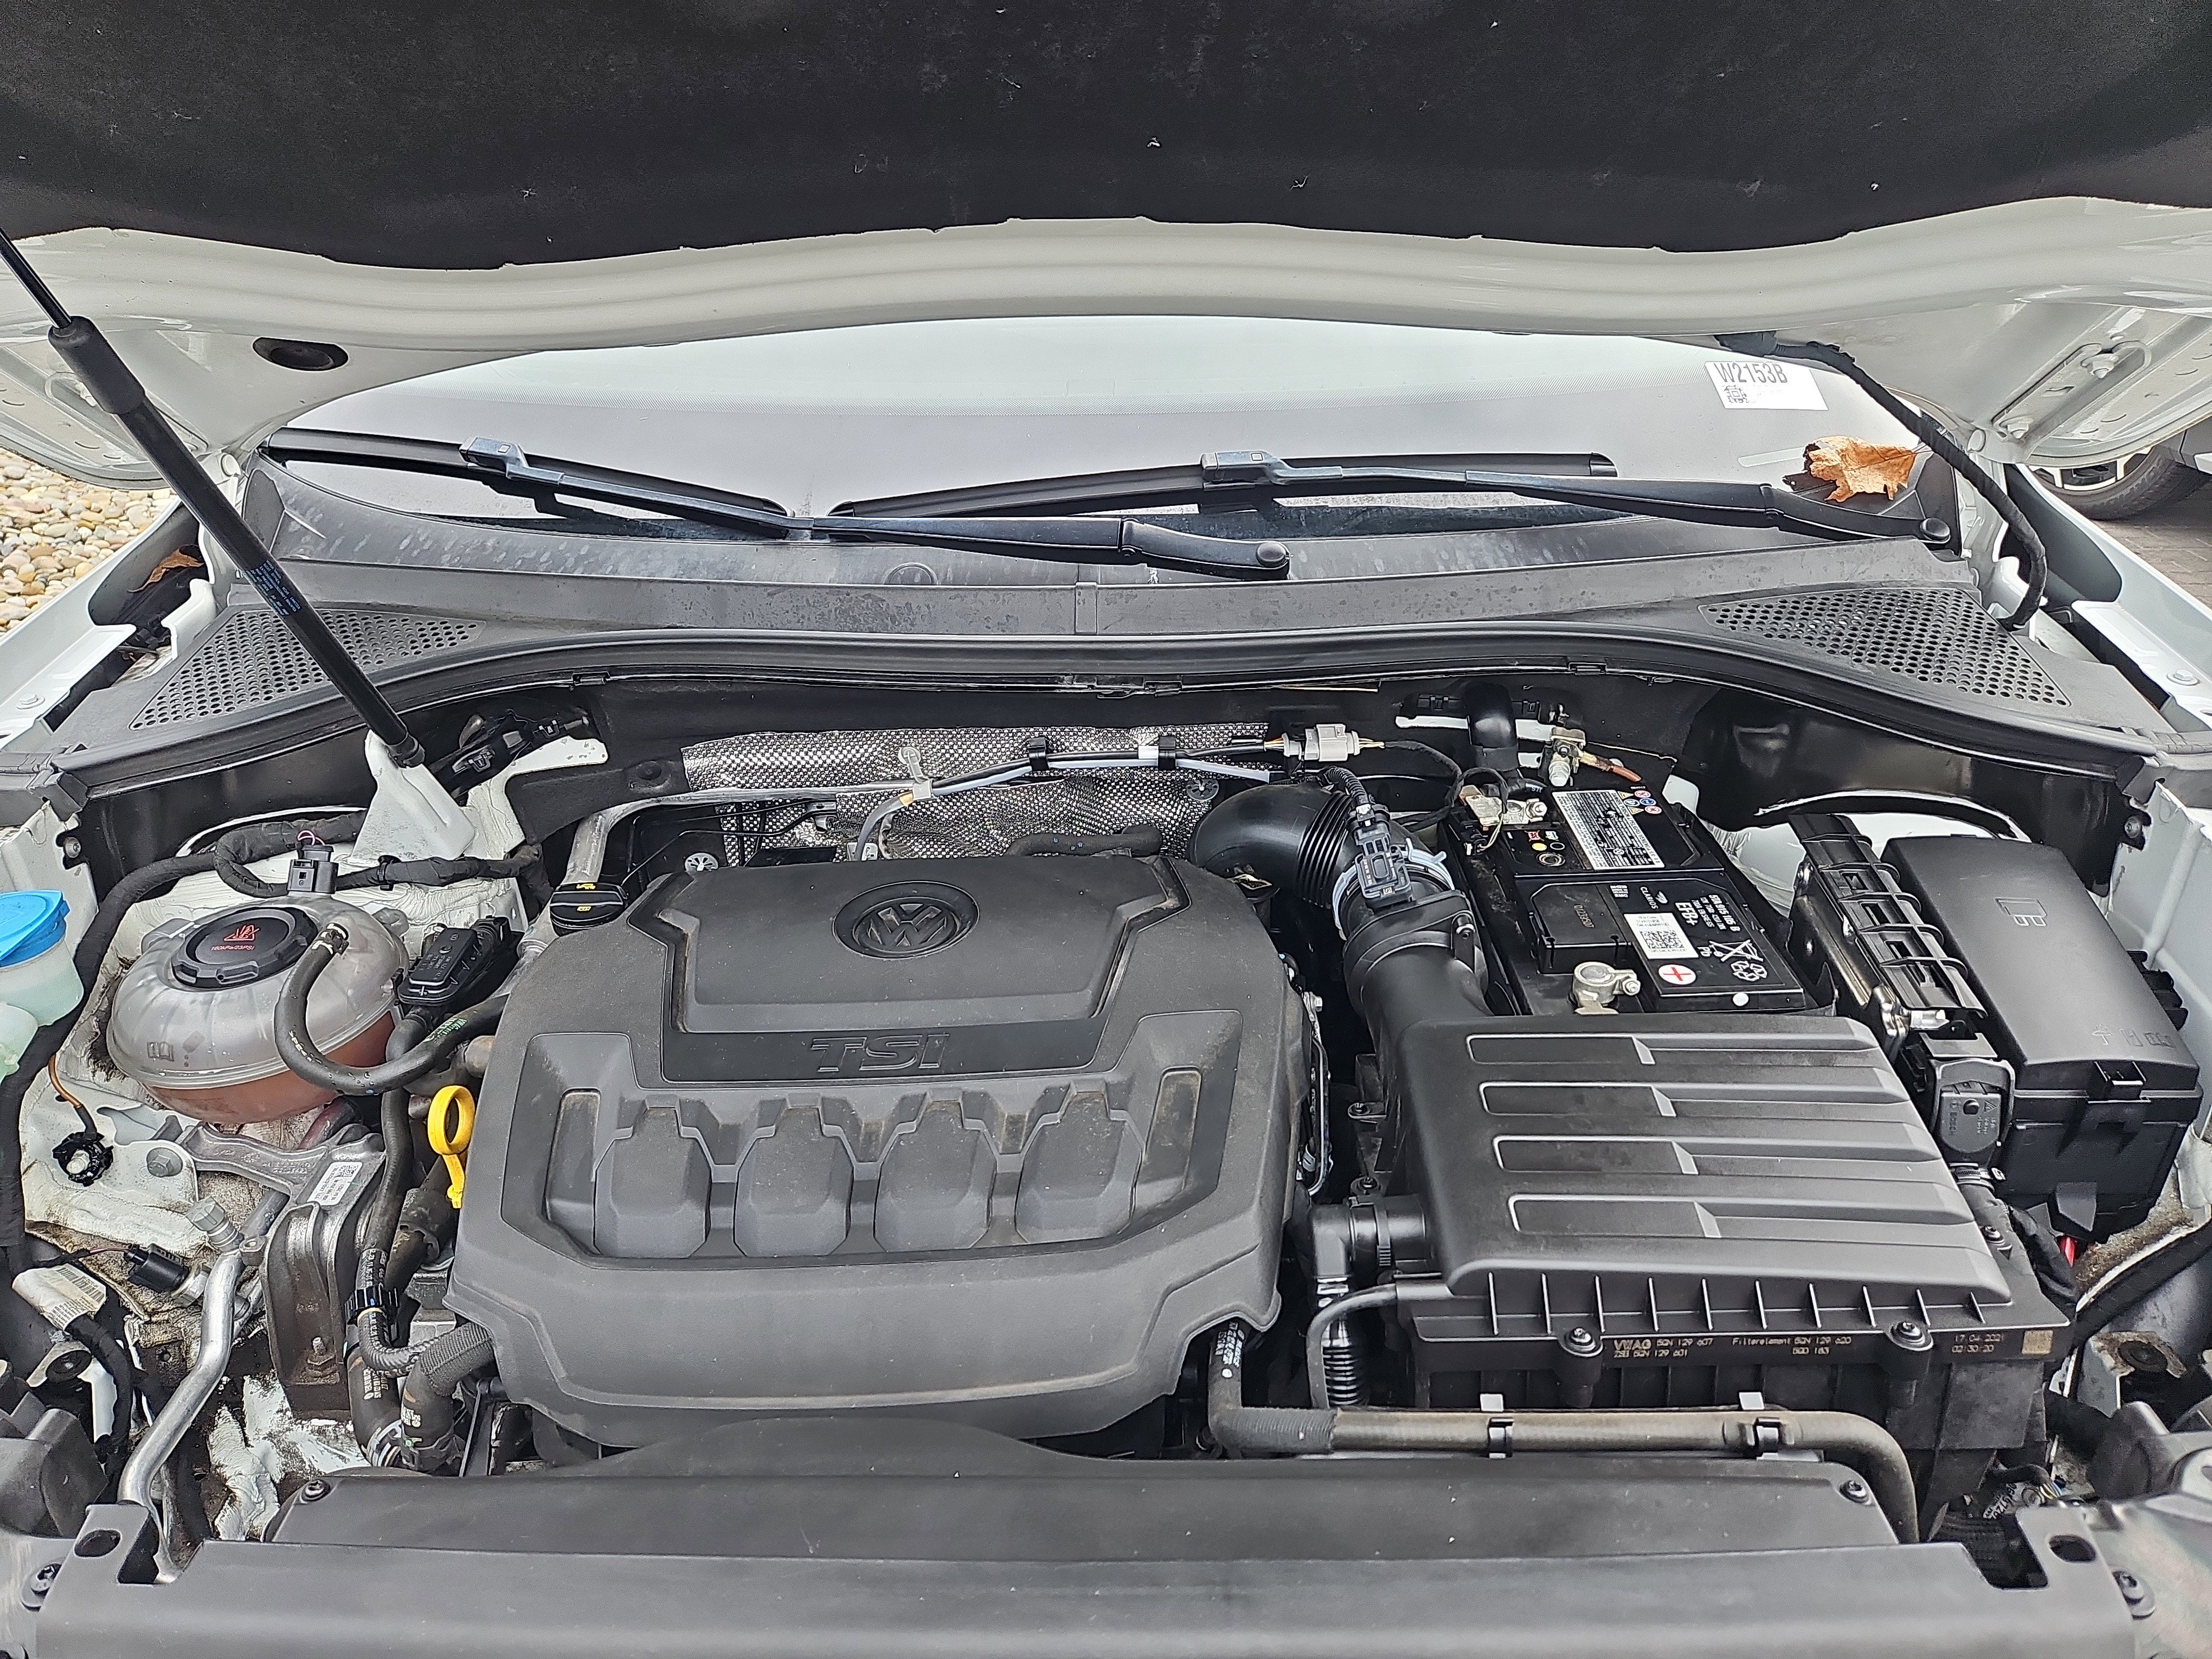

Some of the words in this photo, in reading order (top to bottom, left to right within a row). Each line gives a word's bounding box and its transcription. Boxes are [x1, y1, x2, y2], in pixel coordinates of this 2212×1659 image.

[1714, 362, 1788, 383] W2153B
[1640, 886, 1658, 909] CLARIOS
[1715, 904, 1729, 914] 915
[853, 897, 960, 953] VW
[1675, 902, 1699, 926] EFB+
[1697, 947, 1712, 957] Pb
[811, 1034, 949, 1072] TSI
